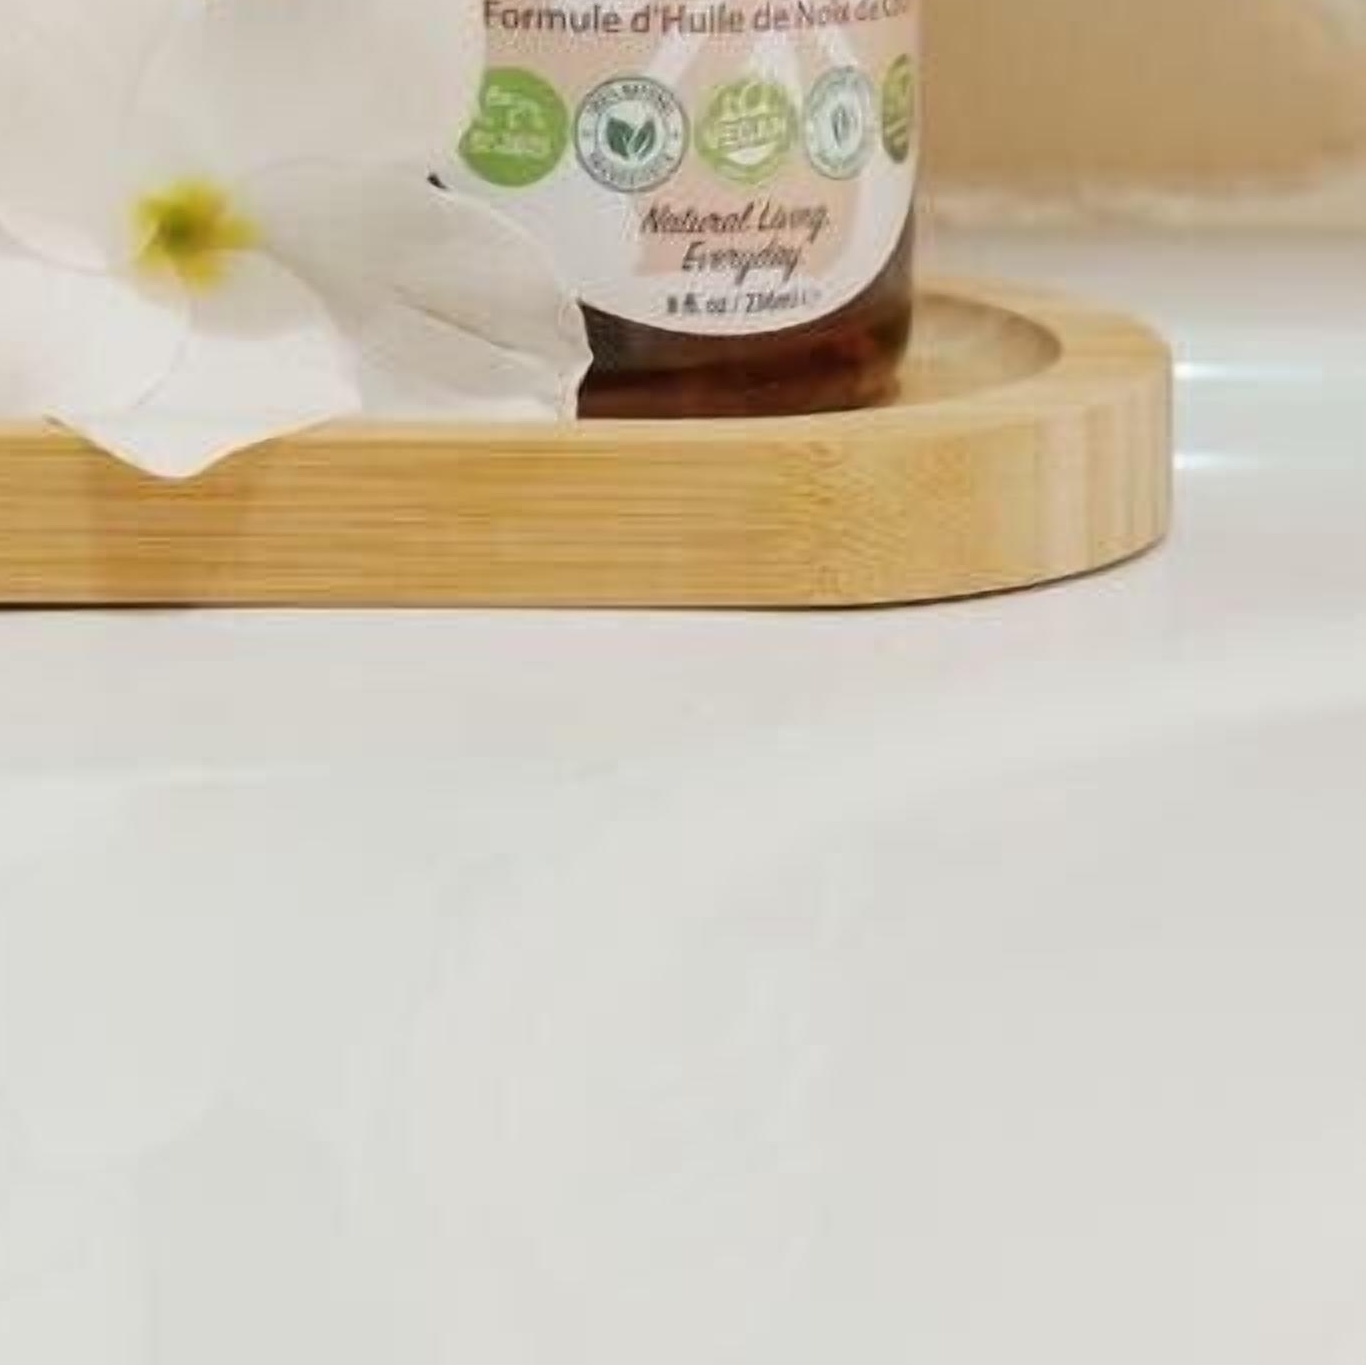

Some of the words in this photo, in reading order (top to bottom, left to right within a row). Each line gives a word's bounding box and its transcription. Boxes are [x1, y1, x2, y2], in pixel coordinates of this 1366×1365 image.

[629, 0, 746, 36] d'Huile
[753, 1, 790, 32] de
[639, 200, 753, 236] Natural
[757, 200, 828, 243] Living
[682, 242, 802, 287] Everyday
[706, 297, 727, 314] oz
